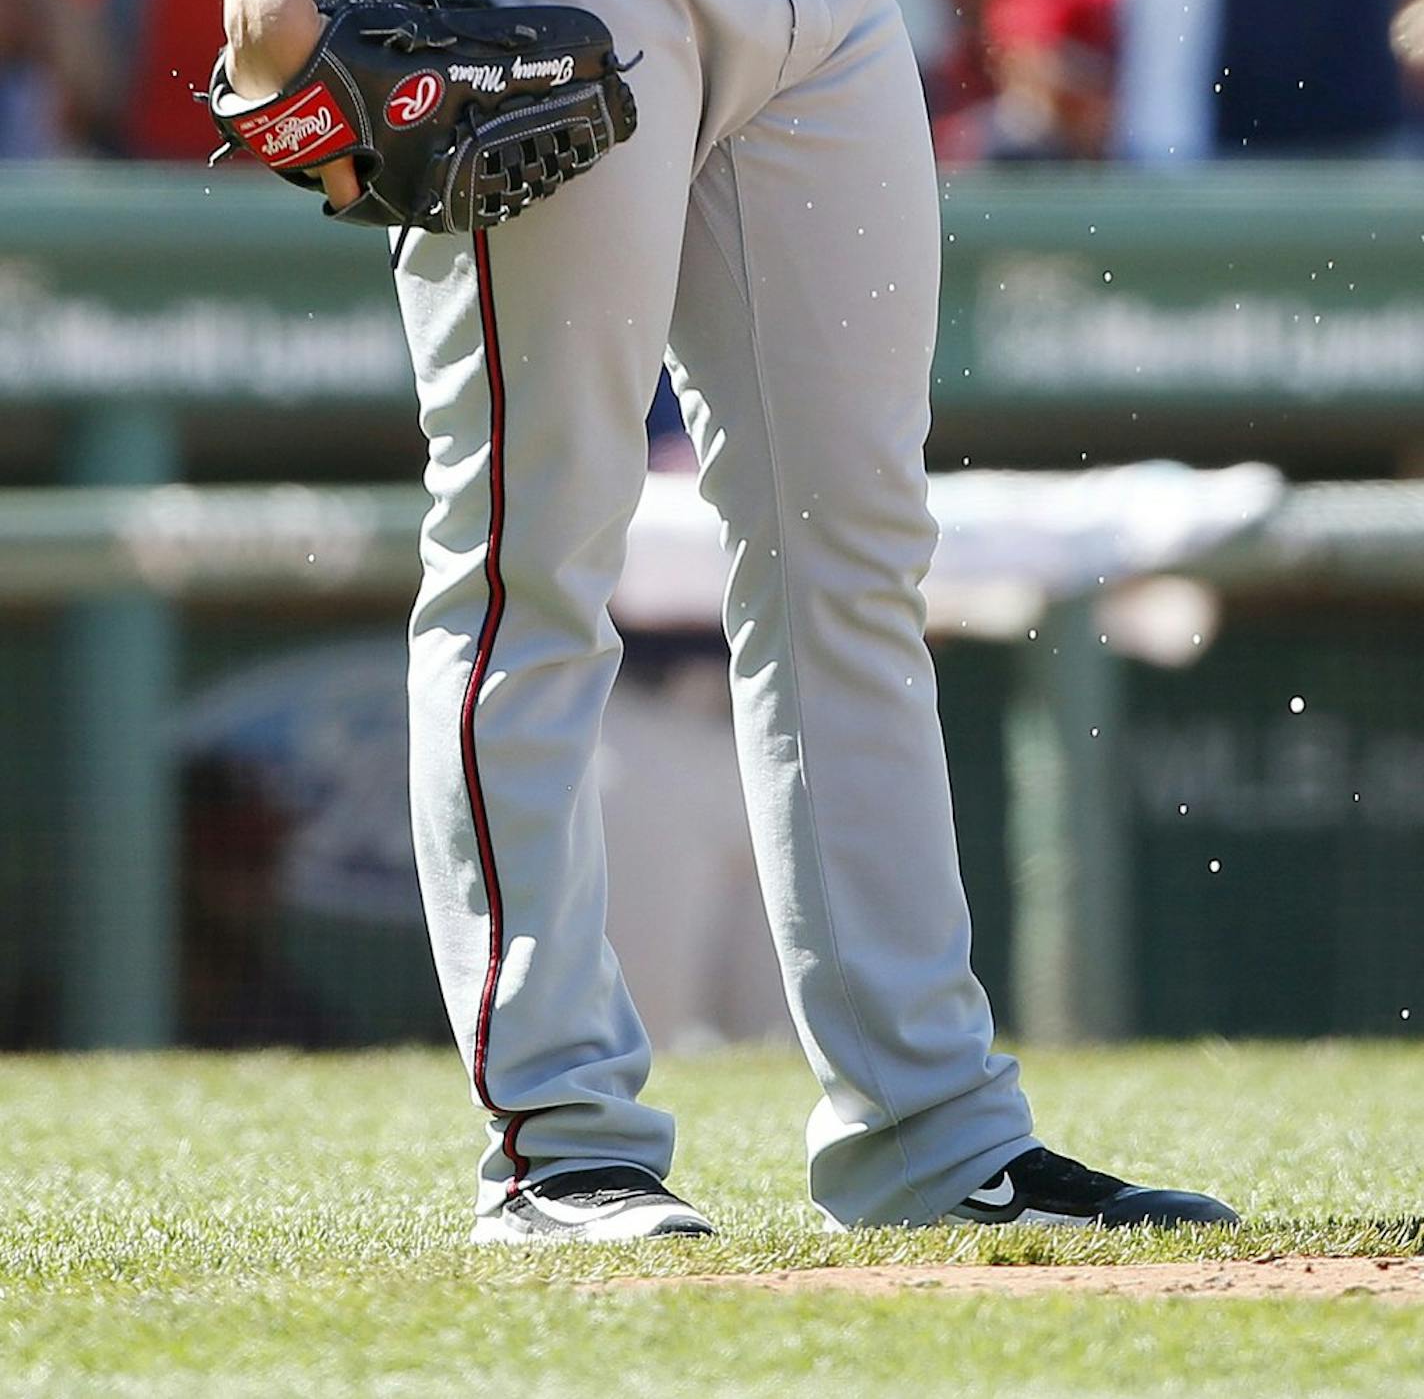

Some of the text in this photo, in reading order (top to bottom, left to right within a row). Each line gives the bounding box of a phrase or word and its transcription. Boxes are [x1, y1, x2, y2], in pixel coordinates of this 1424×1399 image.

[448, 55, 575, 93] Tommy Milone
[262, 106, 332, 156] Rawlings
